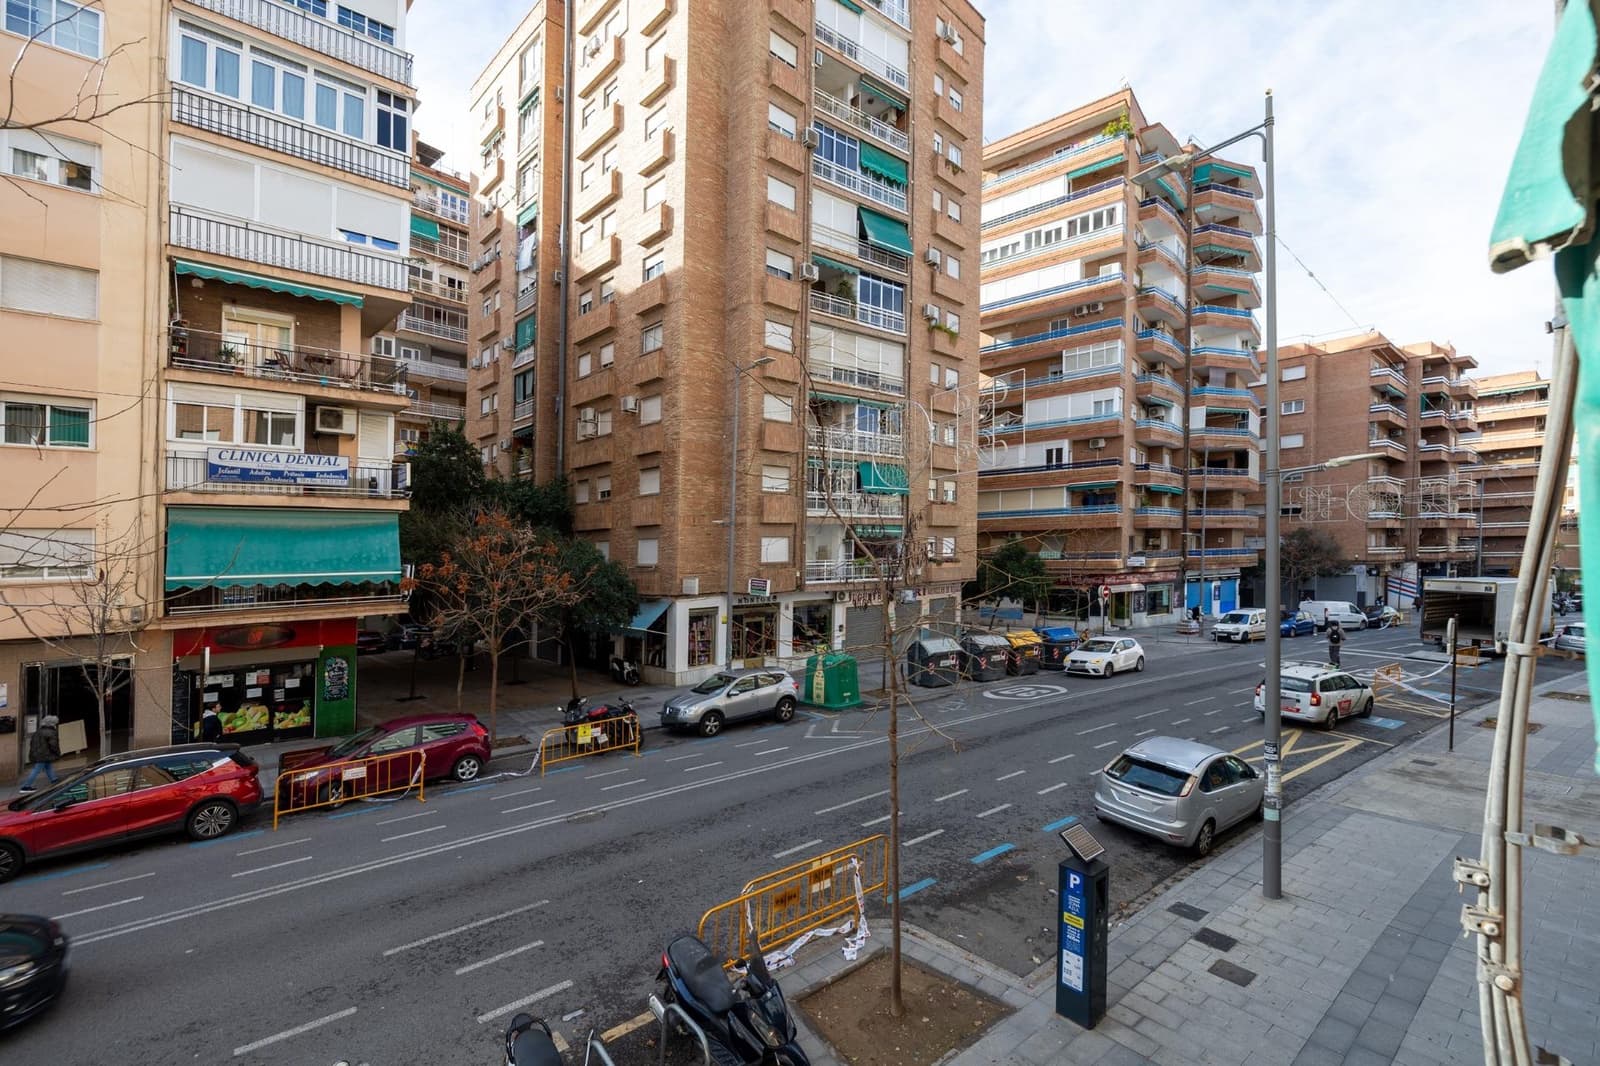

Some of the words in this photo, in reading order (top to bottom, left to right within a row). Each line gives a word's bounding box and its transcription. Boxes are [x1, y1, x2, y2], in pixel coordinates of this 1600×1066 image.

[218, 450, 280, 463] CLINICA
[286, 454, 340, 466] DENTAL
[1070, 873, 1080, 888] P
